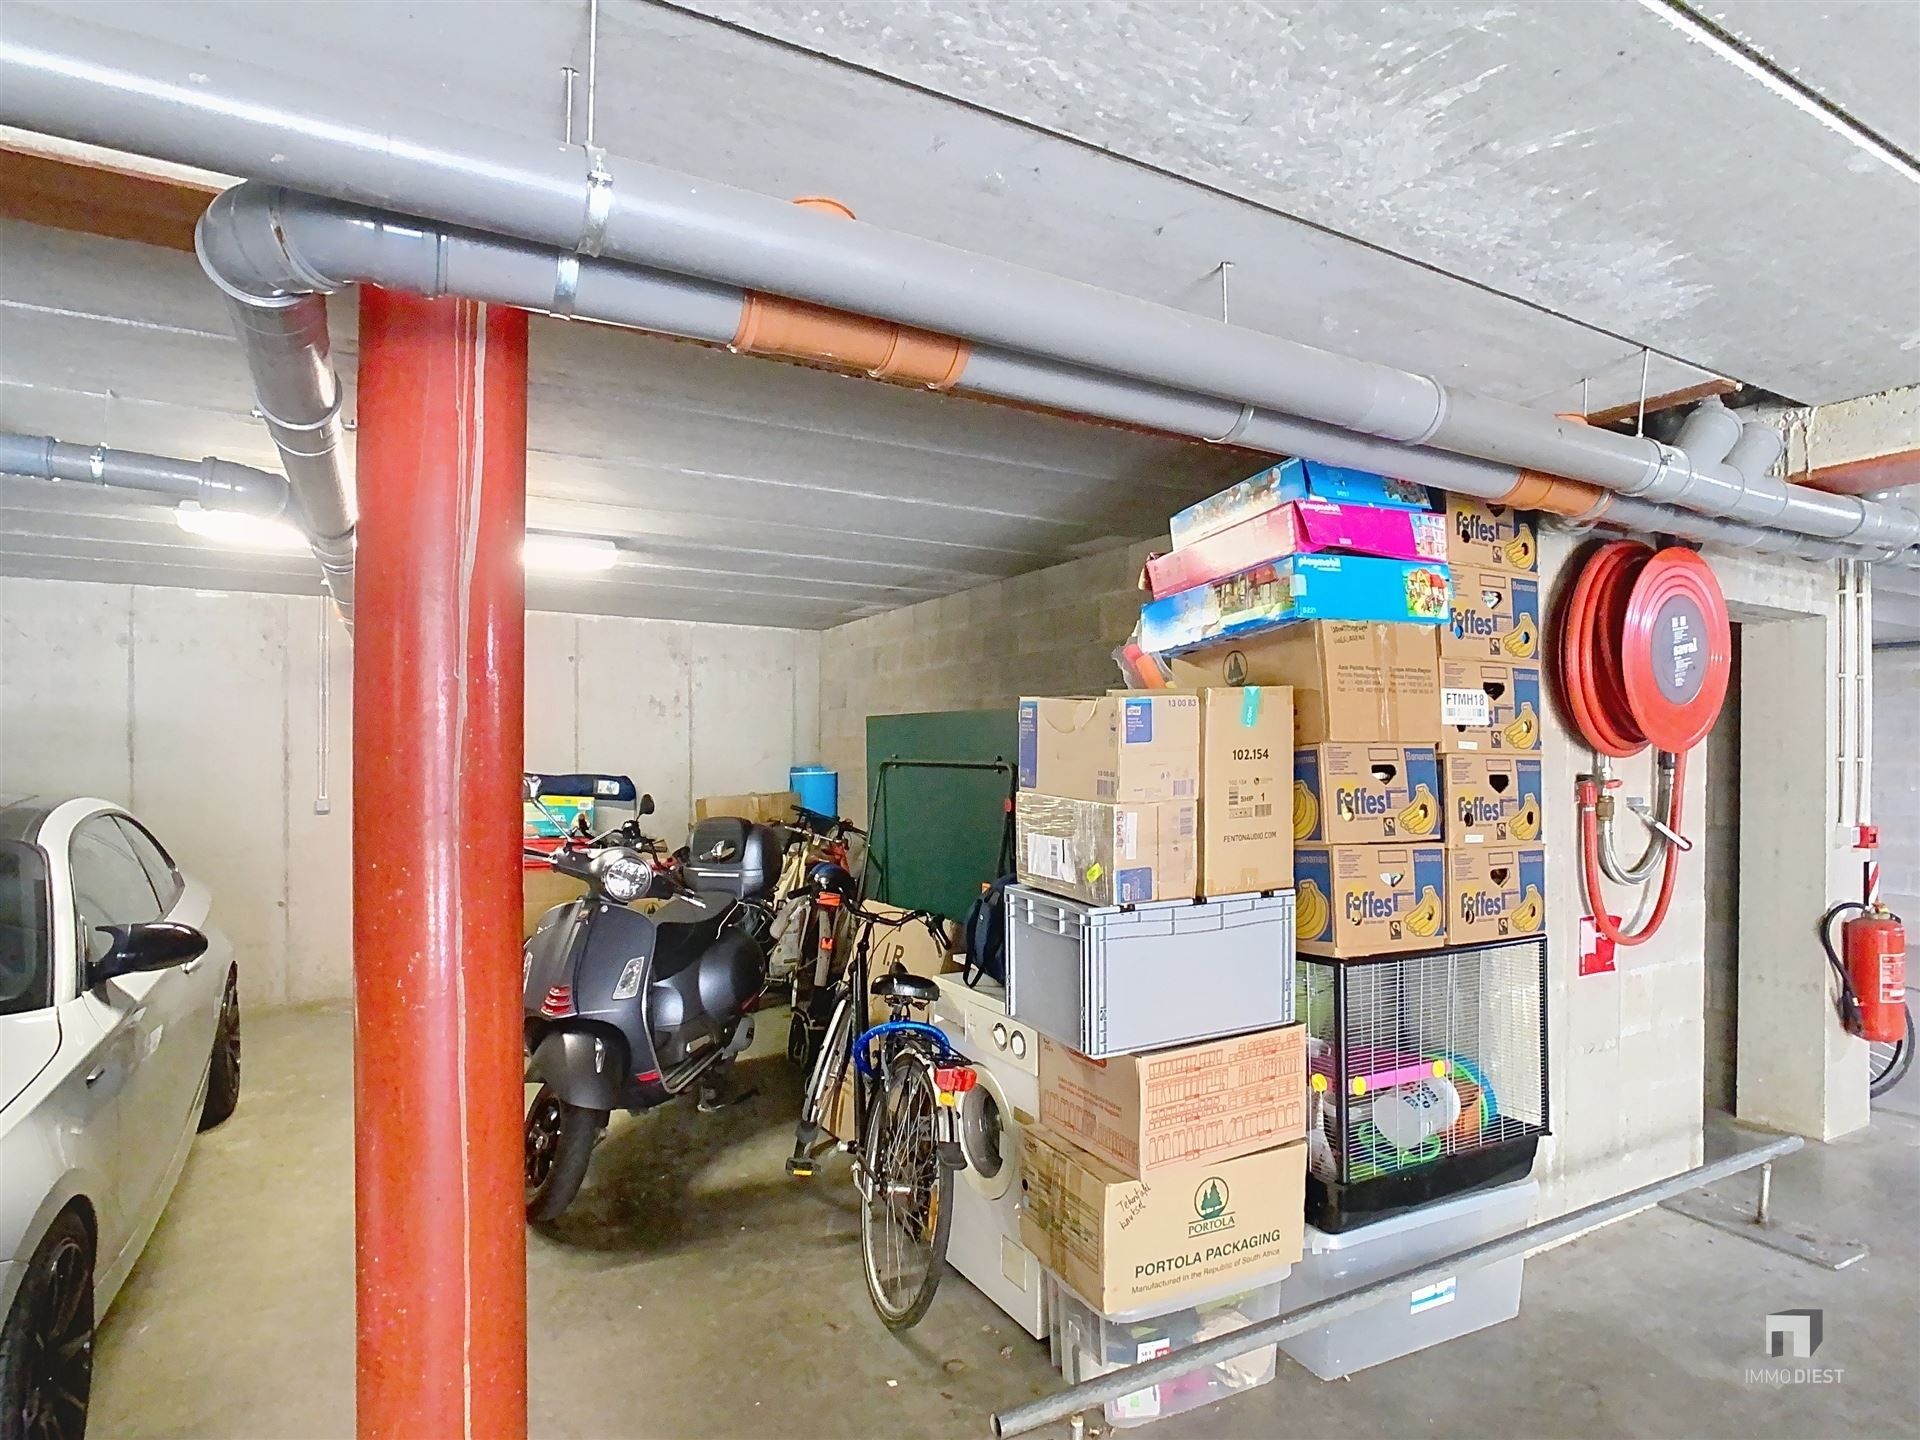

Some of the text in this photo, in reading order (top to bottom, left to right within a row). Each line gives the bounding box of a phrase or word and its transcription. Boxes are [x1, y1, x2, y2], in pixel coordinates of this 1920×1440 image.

[1446, 692, 1485, 706] FTMH18
[1232, 748, 1269, 760] 102.154
[1260, 792, 1265, 802] 1
[1223, 831, 1277, 843] FENTONAUDIO.COM
[1188, 1215, 1235, 1235] PORTOLA
[1135, 1229, 1281, 1278] PORTOLA PACKAGING
[1131, 1276, 1181, 1294] Manufactured
[1191, 1270, 1202, 1278] the
[1203, 1261, 1233, 1277] Republic
[1242, 1253, 1261, 1265] South
[1262, 1248, 1280, 1258] Africa
